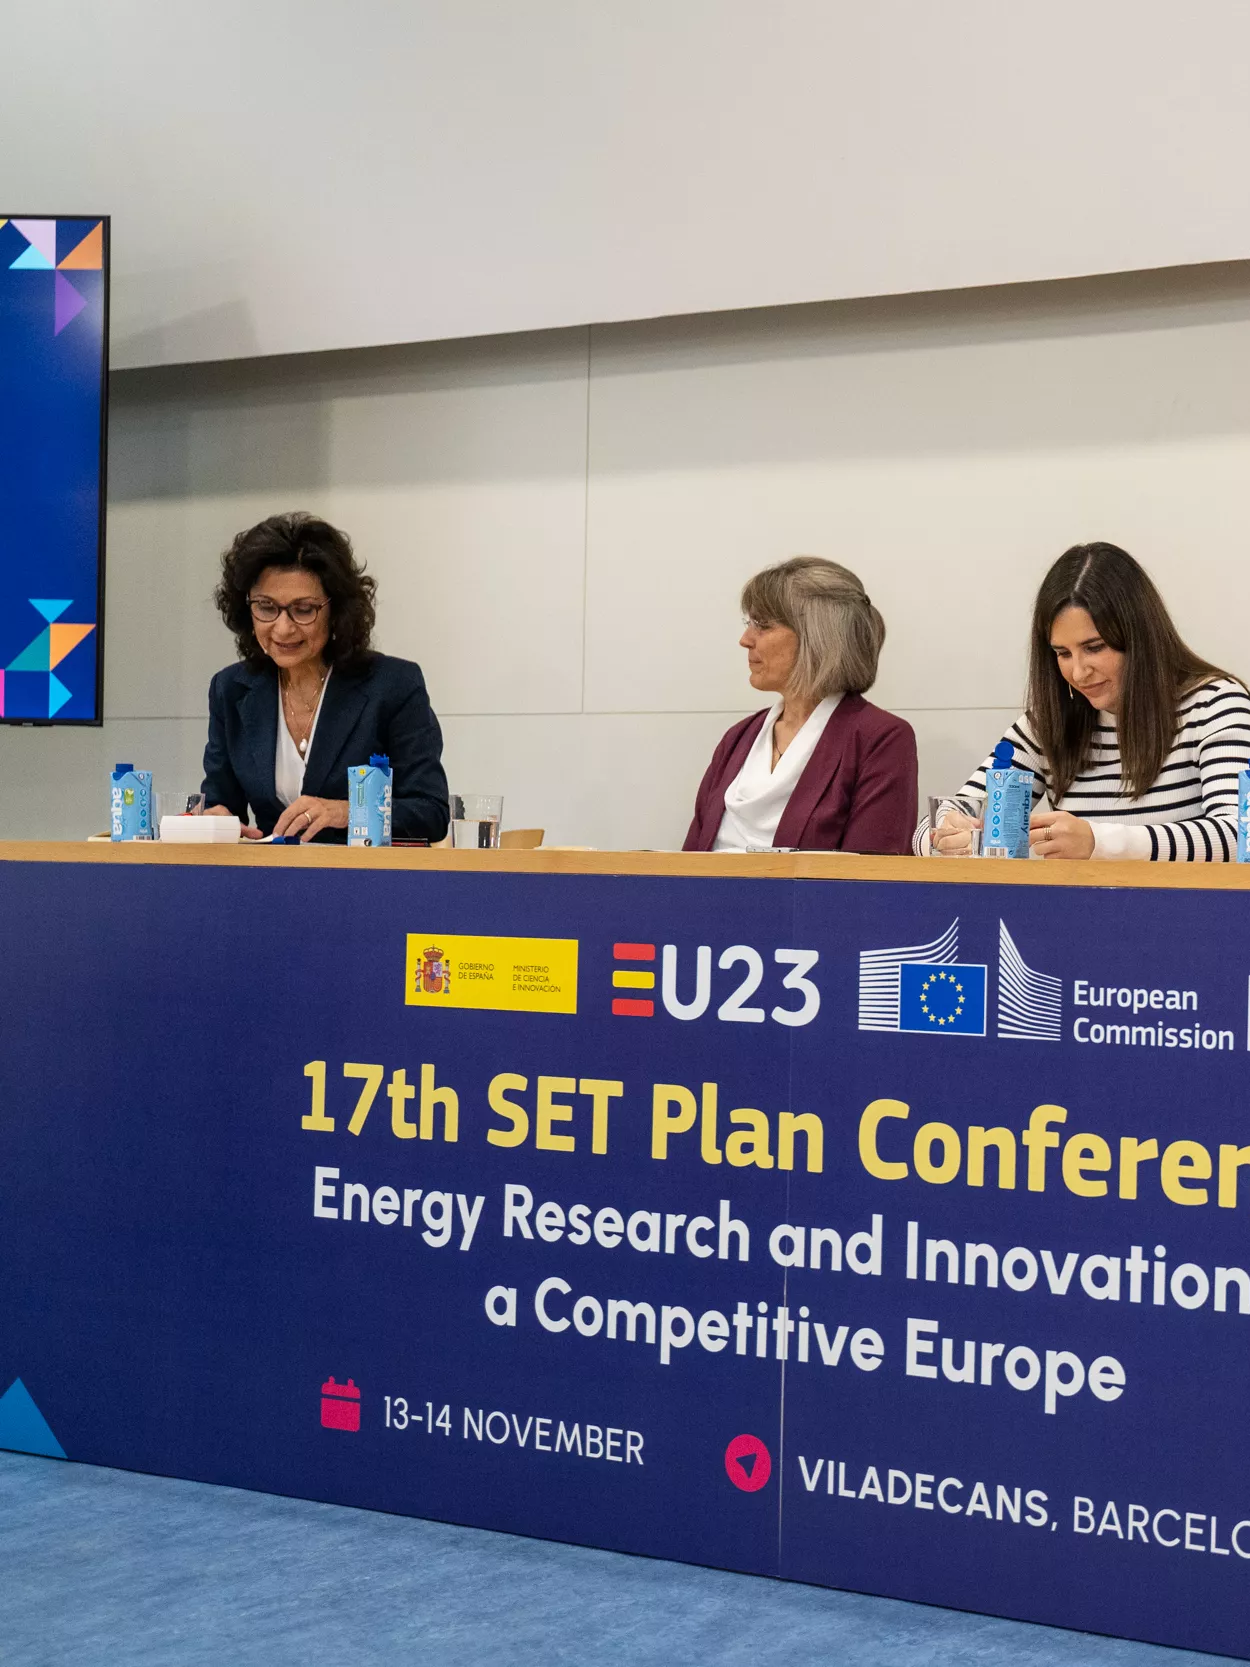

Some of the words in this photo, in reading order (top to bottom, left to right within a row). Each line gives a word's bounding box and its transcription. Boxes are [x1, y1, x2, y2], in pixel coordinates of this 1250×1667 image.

[110, 787, 123, 836] aqua
[378, 785, 392, 837] aqua
[1022, 790, 1030, 834] aqualy
[458, 962, 495, 971] GOBIERNO
[458, 971, 467, 980] DE
[468, 971, 494, 980] ESPAÑA
[512, 965, 550, 973] MINISTERIO
[512, 974, 522, 982] DE
[523, 974, 550, 983] CIENCIA
[517, 984, 561, 993] INNOVACIÓN
[1073, 979, 1198, 1015] European
[1073, 1017, 1234, 1051] Commission
[301, 1060, 459, 1143] 17th
[486, 1072, 624, 1155] SET
[651, 1082, 824, 1173] Plan
[313, 1165, 486, 1252] Energy
[503, 1183, 750, 1262] Research
[768, 1213, 883, 1276] and
[484, 1285, 517, 1327] a
[534, 1276, 885, 1372] Competitive
[905, 1317, 1126, 1415] Europe
[384, 1395, 452, 1436] 13-14
[463, 1407, 644, 1465] NOVEMBER
[798, 1455, 1058, 1532] VILADECANS,
